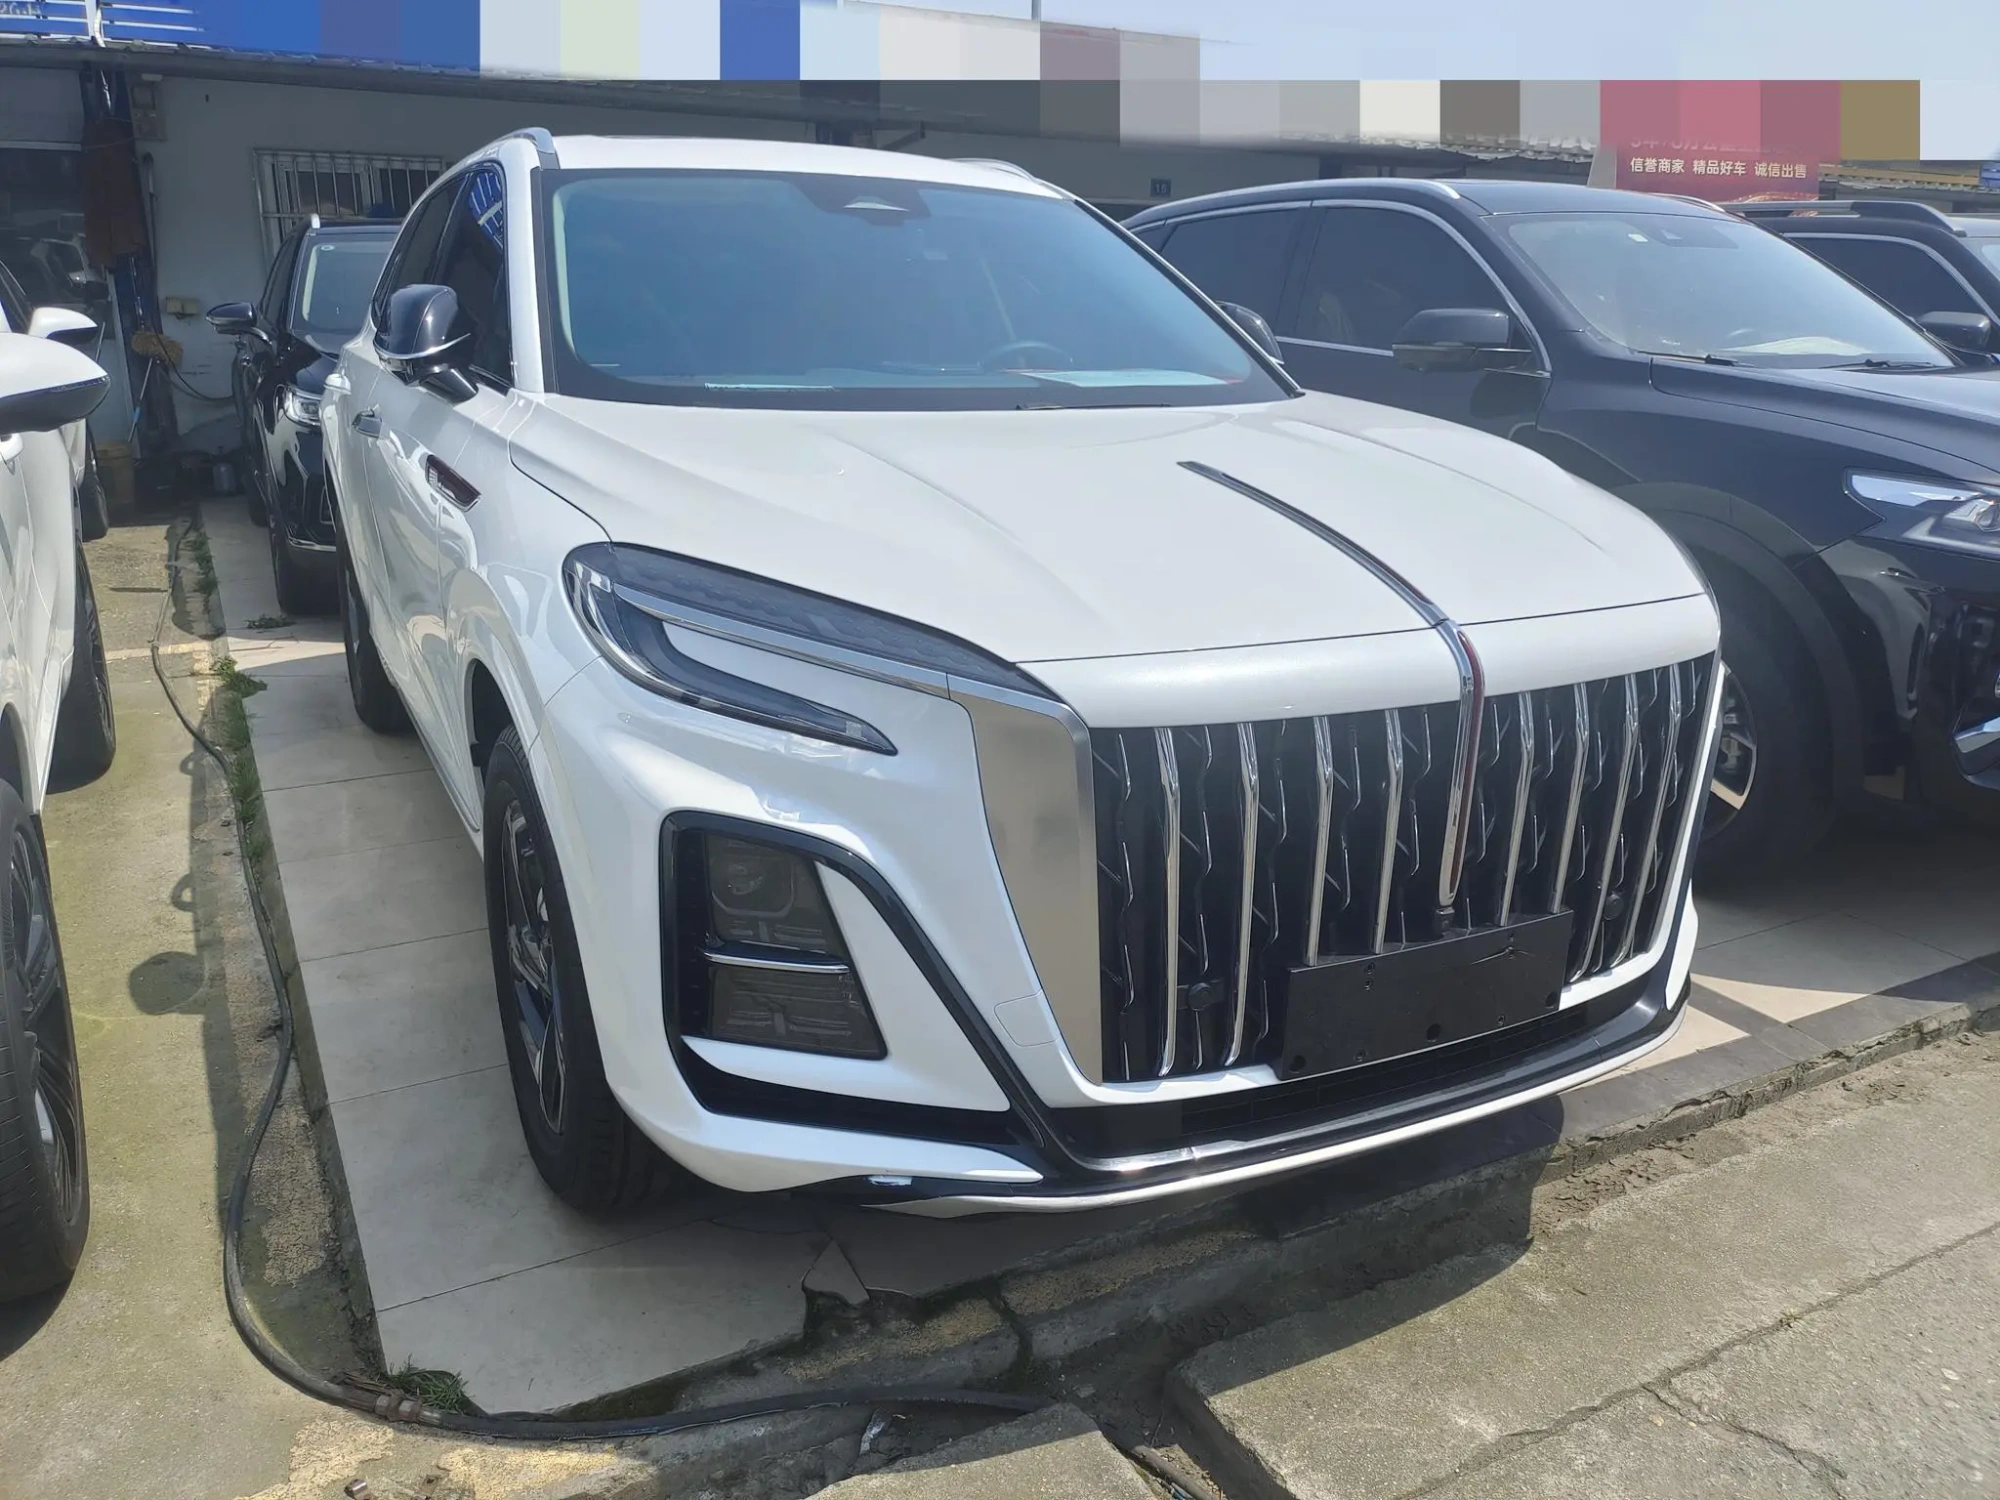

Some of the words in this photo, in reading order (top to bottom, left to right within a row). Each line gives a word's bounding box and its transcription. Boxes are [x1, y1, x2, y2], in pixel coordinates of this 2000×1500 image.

[1630, 157, 1685, 174] 信誉商家
[1692, 159, 1747, 176] 精品好车
[1754, 162, 1808, 179] 诚信出售
